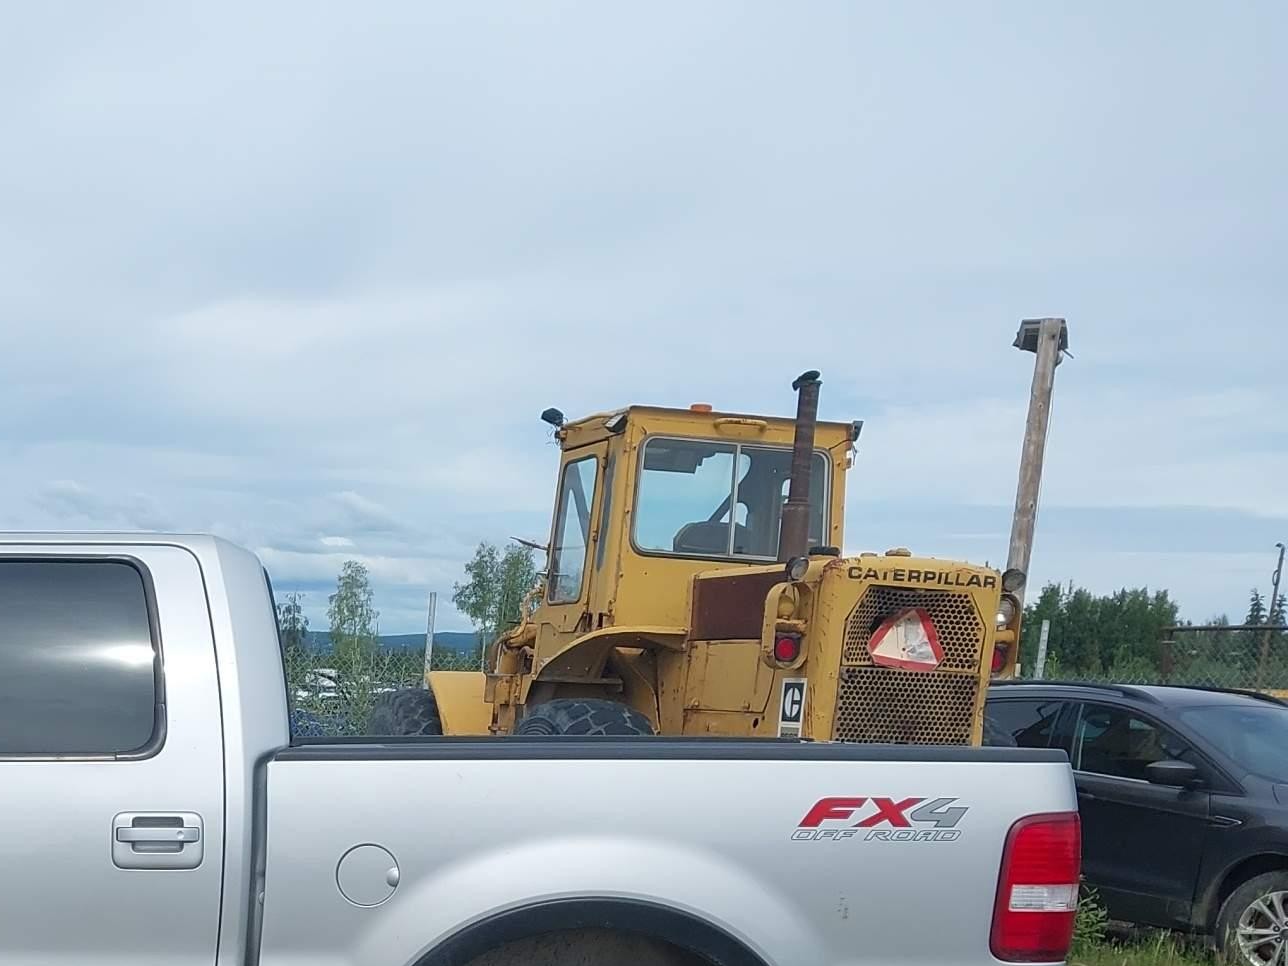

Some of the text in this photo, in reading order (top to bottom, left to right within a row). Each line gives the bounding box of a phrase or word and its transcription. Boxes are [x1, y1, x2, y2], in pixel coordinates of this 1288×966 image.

[847, 566, 997, 589] CATERPILLAR
[797, 796, 970, 828] FX4
[790, 829, 962, 842] OFF ROAD
